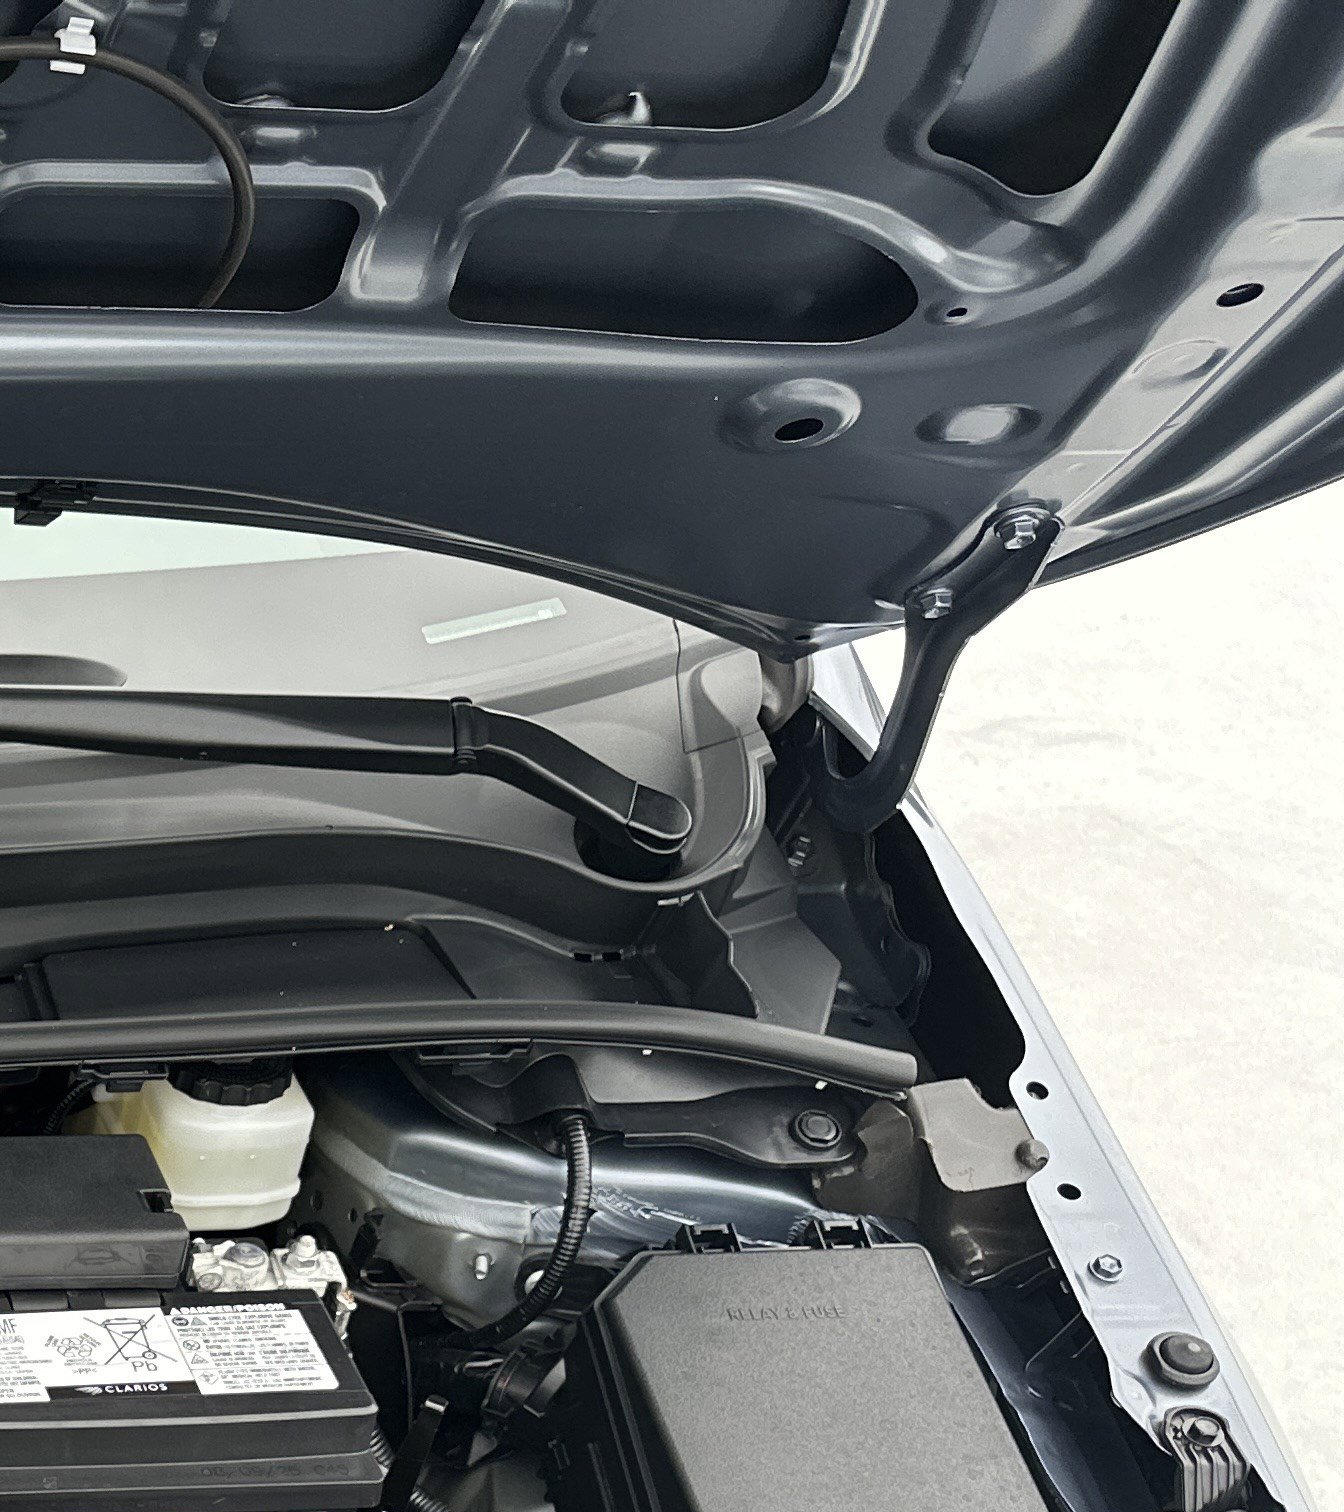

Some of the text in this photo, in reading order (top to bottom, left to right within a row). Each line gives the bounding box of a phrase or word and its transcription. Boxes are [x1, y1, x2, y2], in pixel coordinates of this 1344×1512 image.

[726, 1306, 780, 1321] RELAY
[802, 1304, 846, 1319] FUSE
[131, 1360, 158, 1372] Pb
[104, 1383, 168, 1394] CLARIOS
